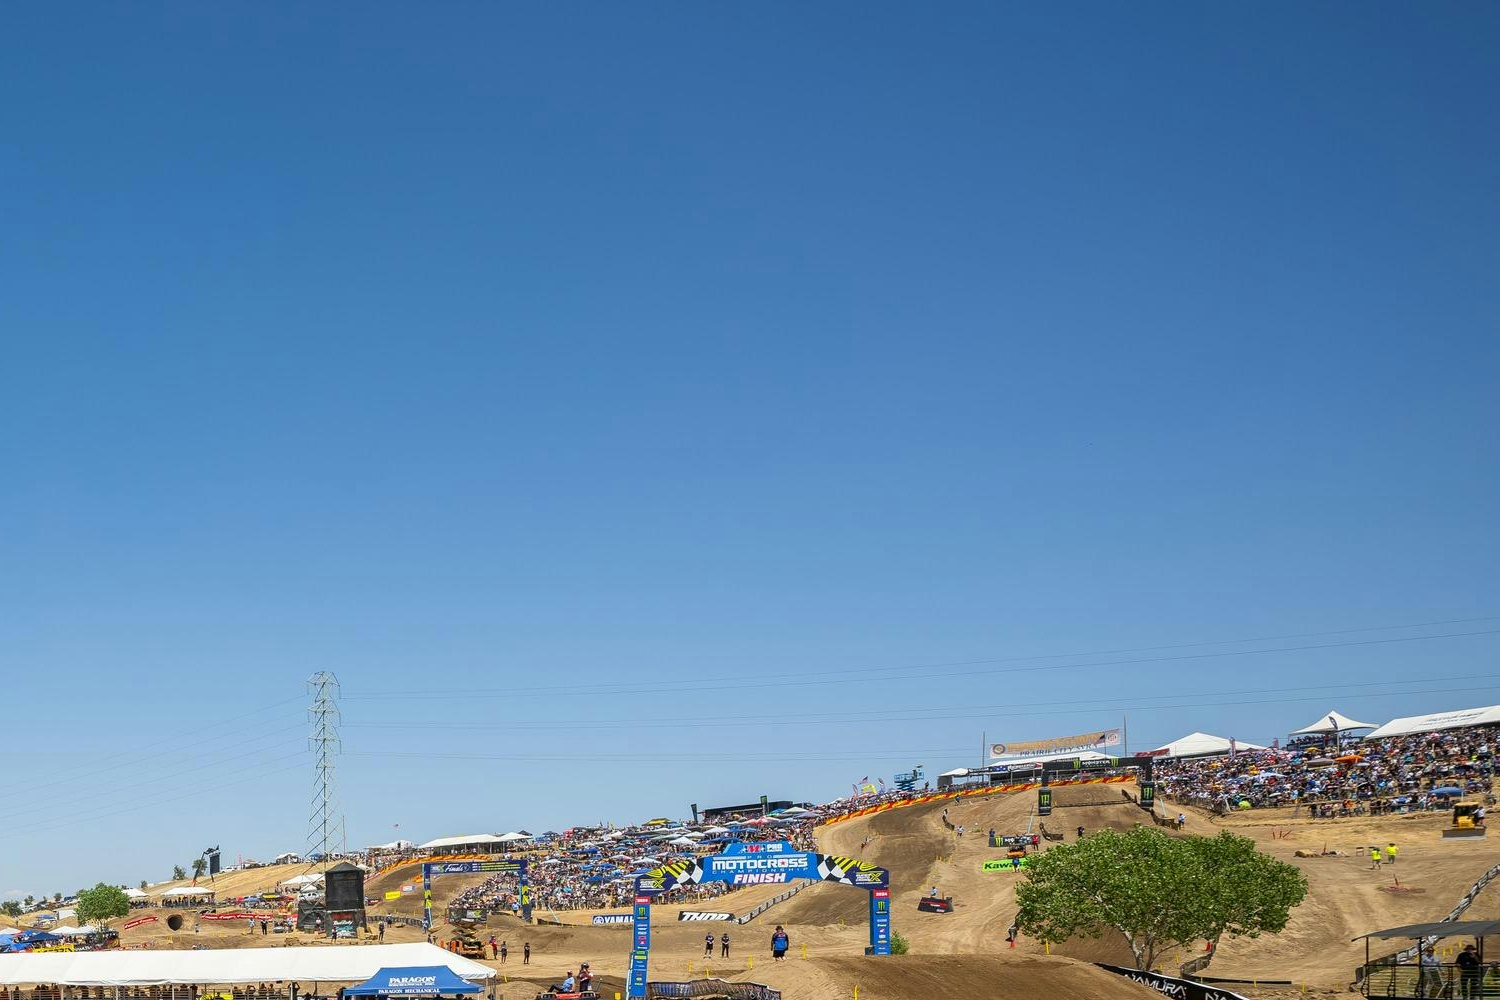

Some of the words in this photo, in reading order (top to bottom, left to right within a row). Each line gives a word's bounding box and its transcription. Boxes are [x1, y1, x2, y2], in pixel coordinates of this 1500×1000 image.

[712, 858, 808, 870] MOTOCROSS
[734, 873, 786, 884] FINISH
[604, 915, 634, 924] YAMAH
[682, 911, 731, 921] THOR
[389, 976, 436, 984] PARAGON
